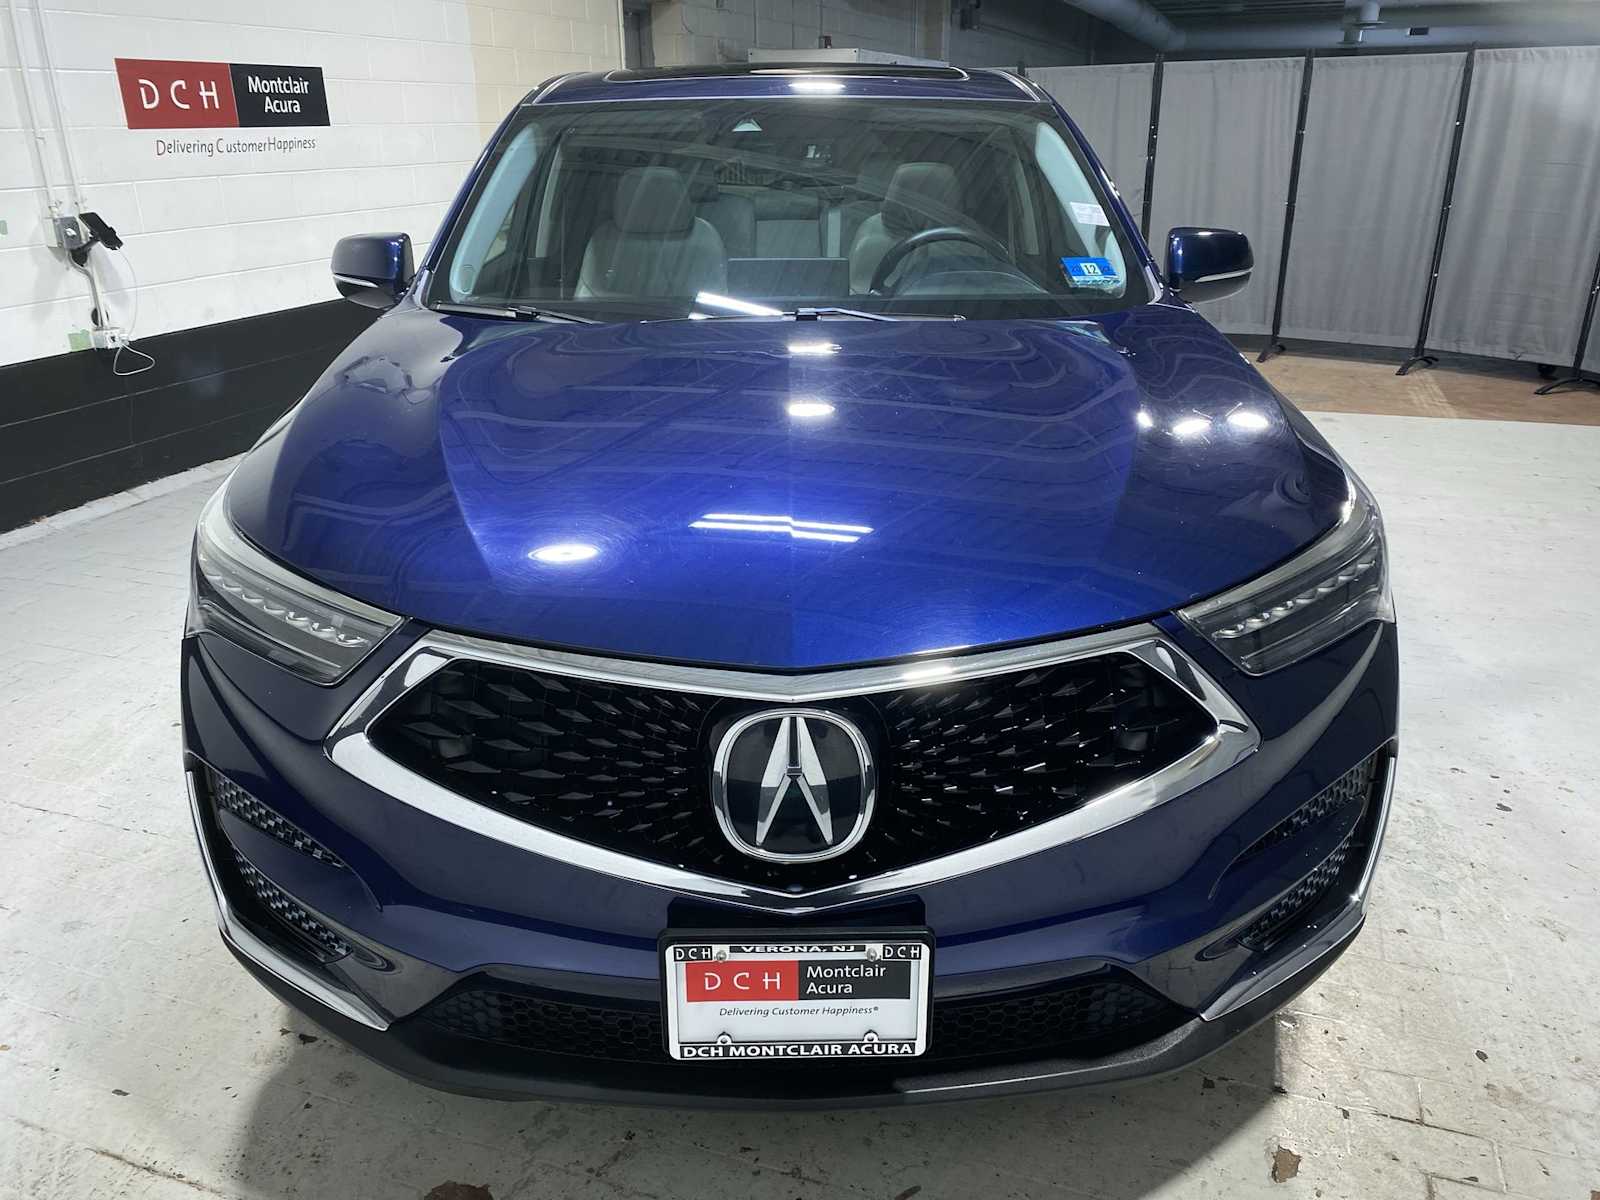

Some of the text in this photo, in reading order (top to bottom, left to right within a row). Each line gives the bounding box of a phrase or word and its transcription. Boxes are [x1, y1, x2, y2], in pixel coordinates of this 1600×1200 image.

[247, 76, 309, 94] Montclair
[264, 96, 301, 113] Acura
[156, 139, 214, 157] Delivering
[1084, 264, 1099, 275] 12
[741, 945, 827, 953] VERONA,
[806, 964, 887, 979] Montclair
[806, 982, 853, 995] Acura
[719, 1007, 769, 1018] Delivering
[771, 1006, 820, 1017] Customer
[683, 1043, 913, 1058] DCH MONTCLAIR ACURA
